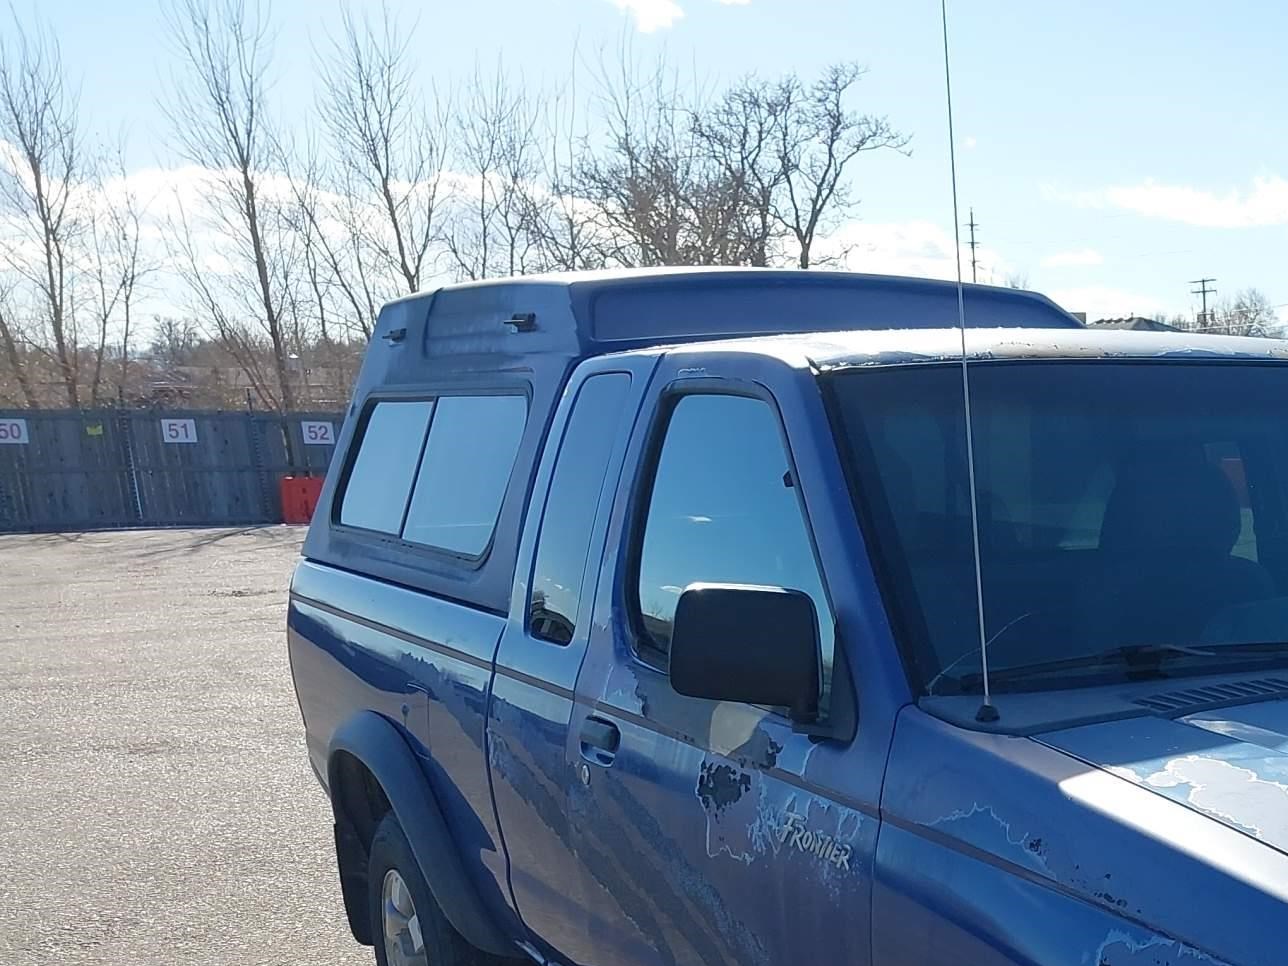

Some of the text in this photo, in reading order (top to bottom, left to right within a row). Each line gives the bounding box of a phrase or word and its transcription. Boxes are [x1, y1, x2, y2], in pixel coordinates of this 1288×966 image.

[0, 423, 21, 439] 50
[168, 423, 189, 439] 51
[308, 425, 330, 440] 52
[779, 811, 853, 871] FRONTIER
